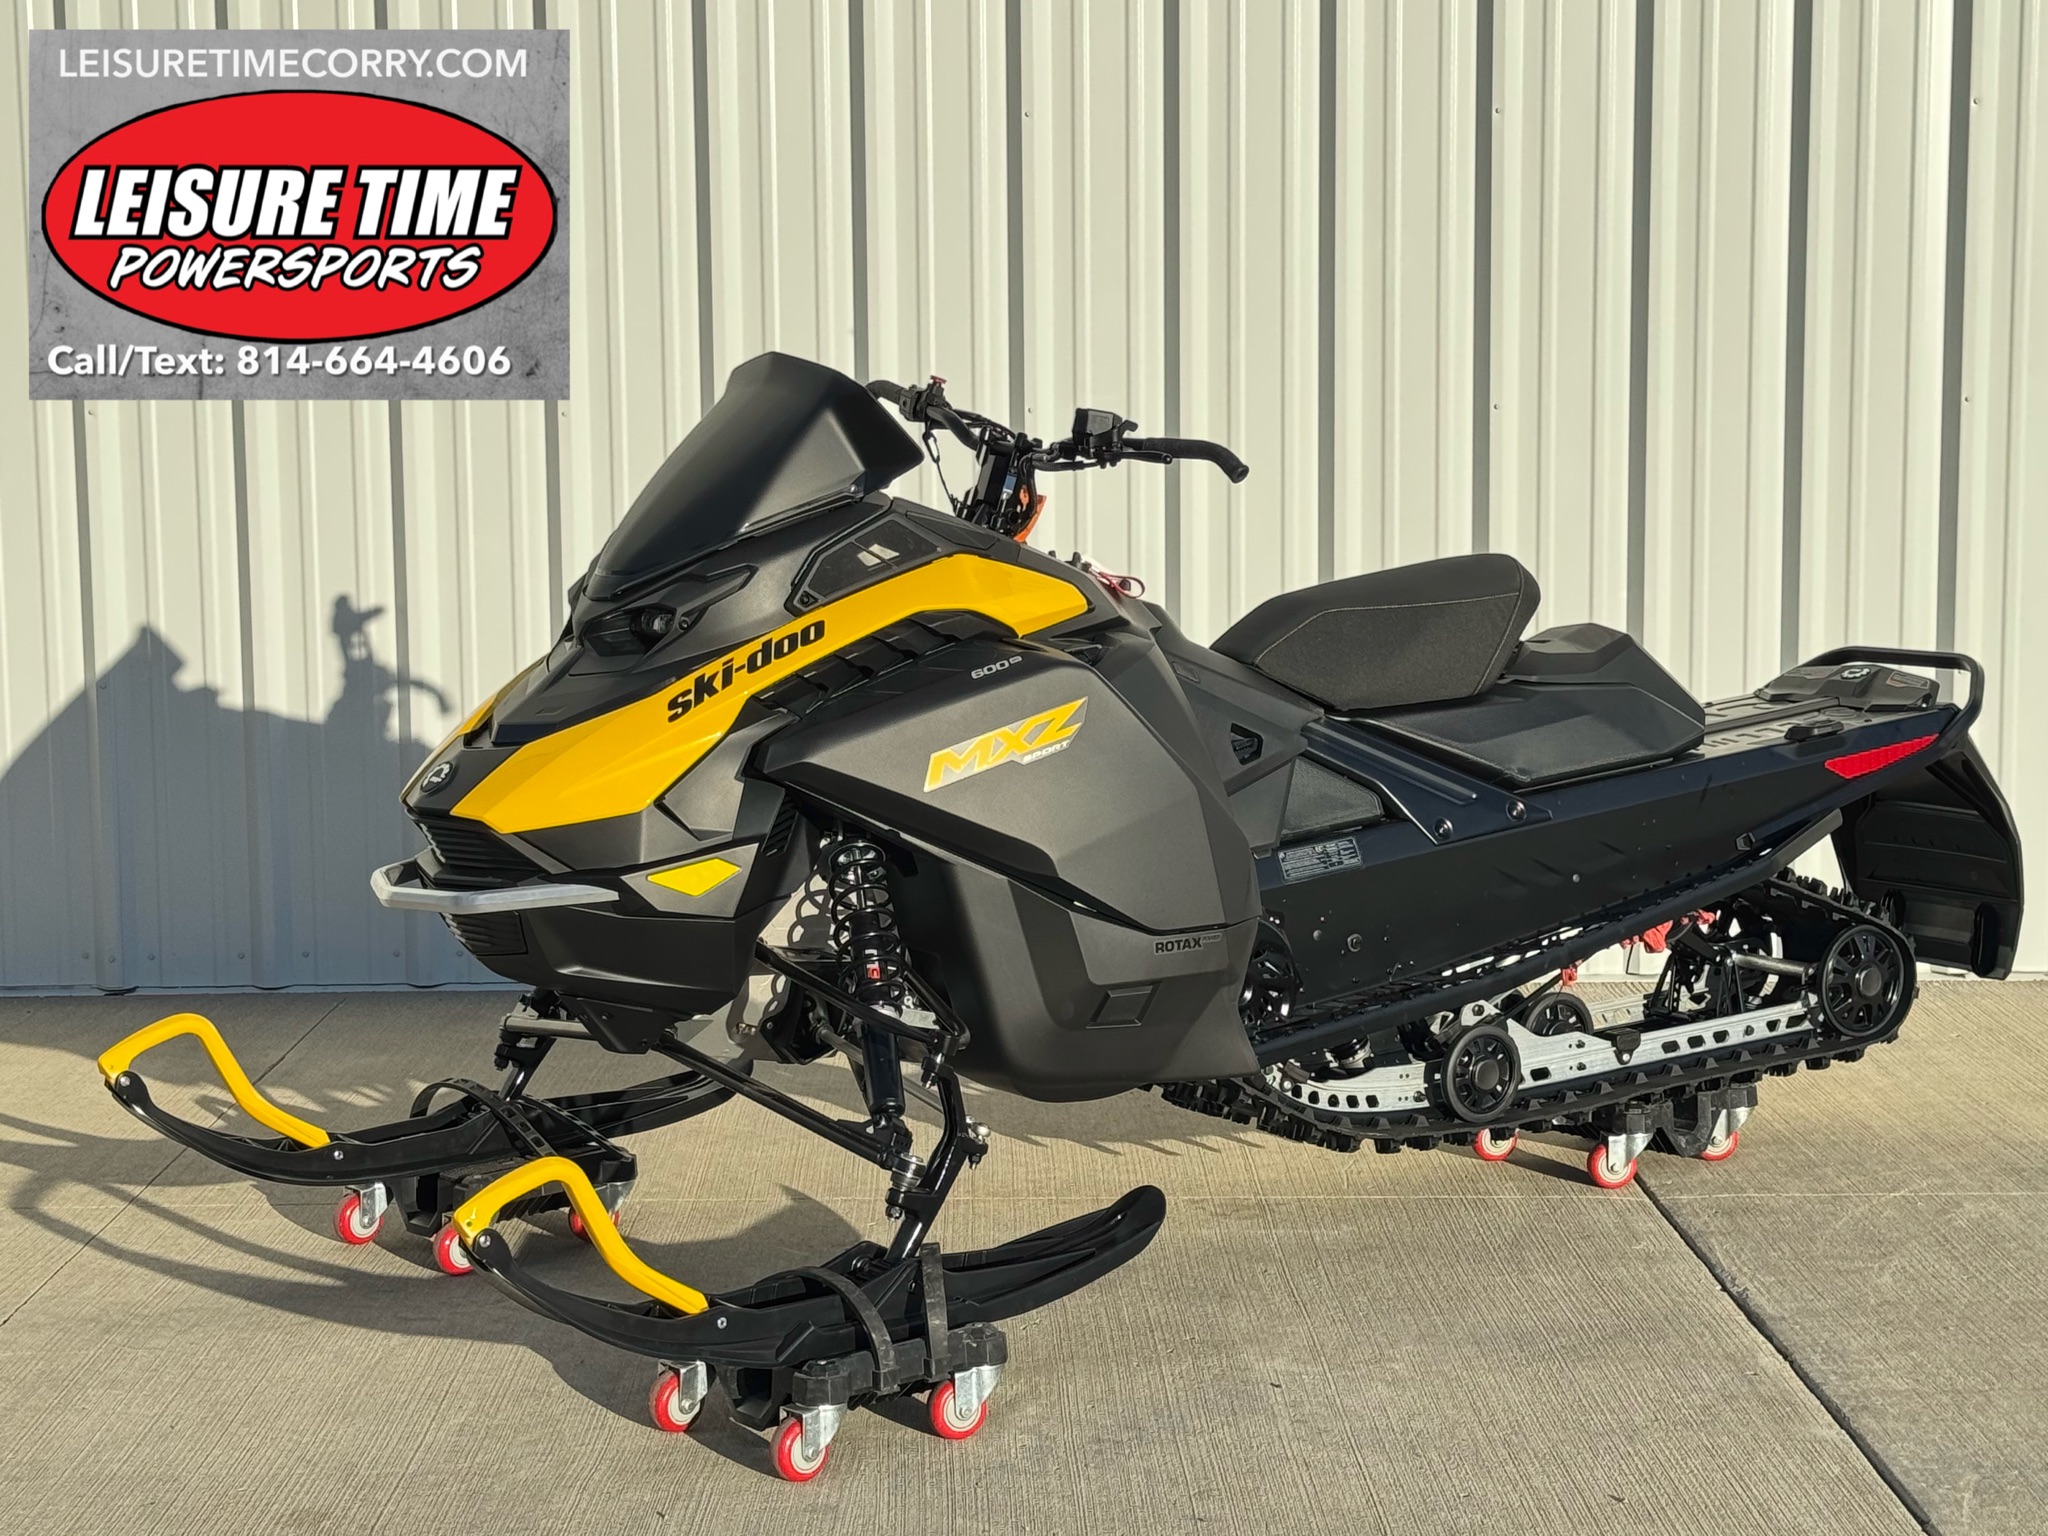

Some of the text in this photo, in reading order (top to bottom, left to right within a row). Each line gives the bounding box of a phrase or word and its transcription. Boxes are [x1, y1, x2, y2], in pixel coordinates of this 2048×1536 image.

[971, 659, 1010, 680] 600
[925, 697, 1087, 791] MXZ
[1155, 937, 1202, 953] ROTAX
